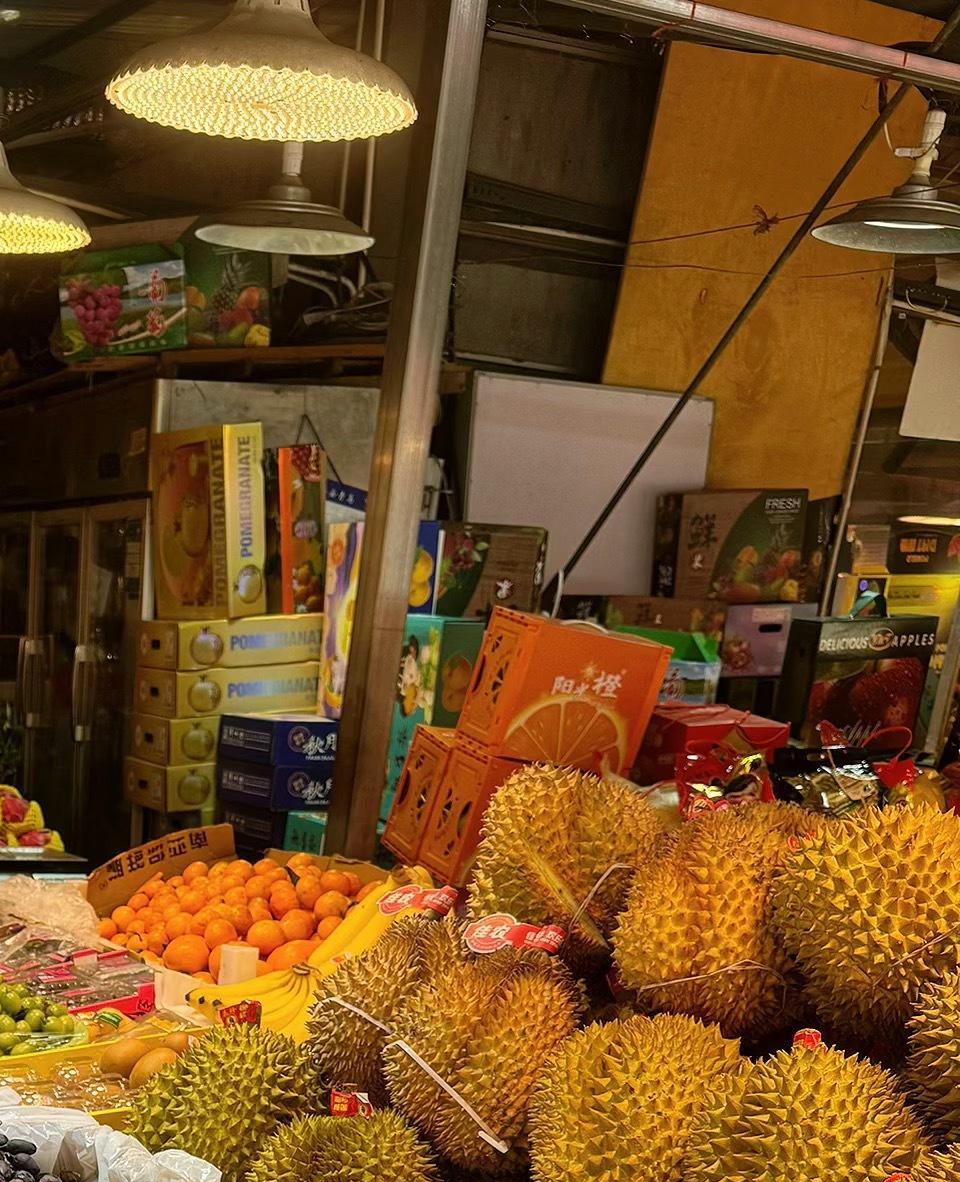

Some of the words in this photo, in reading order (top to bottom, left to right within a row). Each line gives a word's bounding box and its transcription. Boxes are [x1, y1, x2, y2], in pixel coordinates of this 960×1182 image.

[237, 435, 253, 558] POMEGRANATE
[765, 498, 801, 510] FRESH
[818, 636, 869, 652] DELICIOUS
[891, 633, 935, 648] APPLES
[551, 671, 621, 699] 阳光橙
